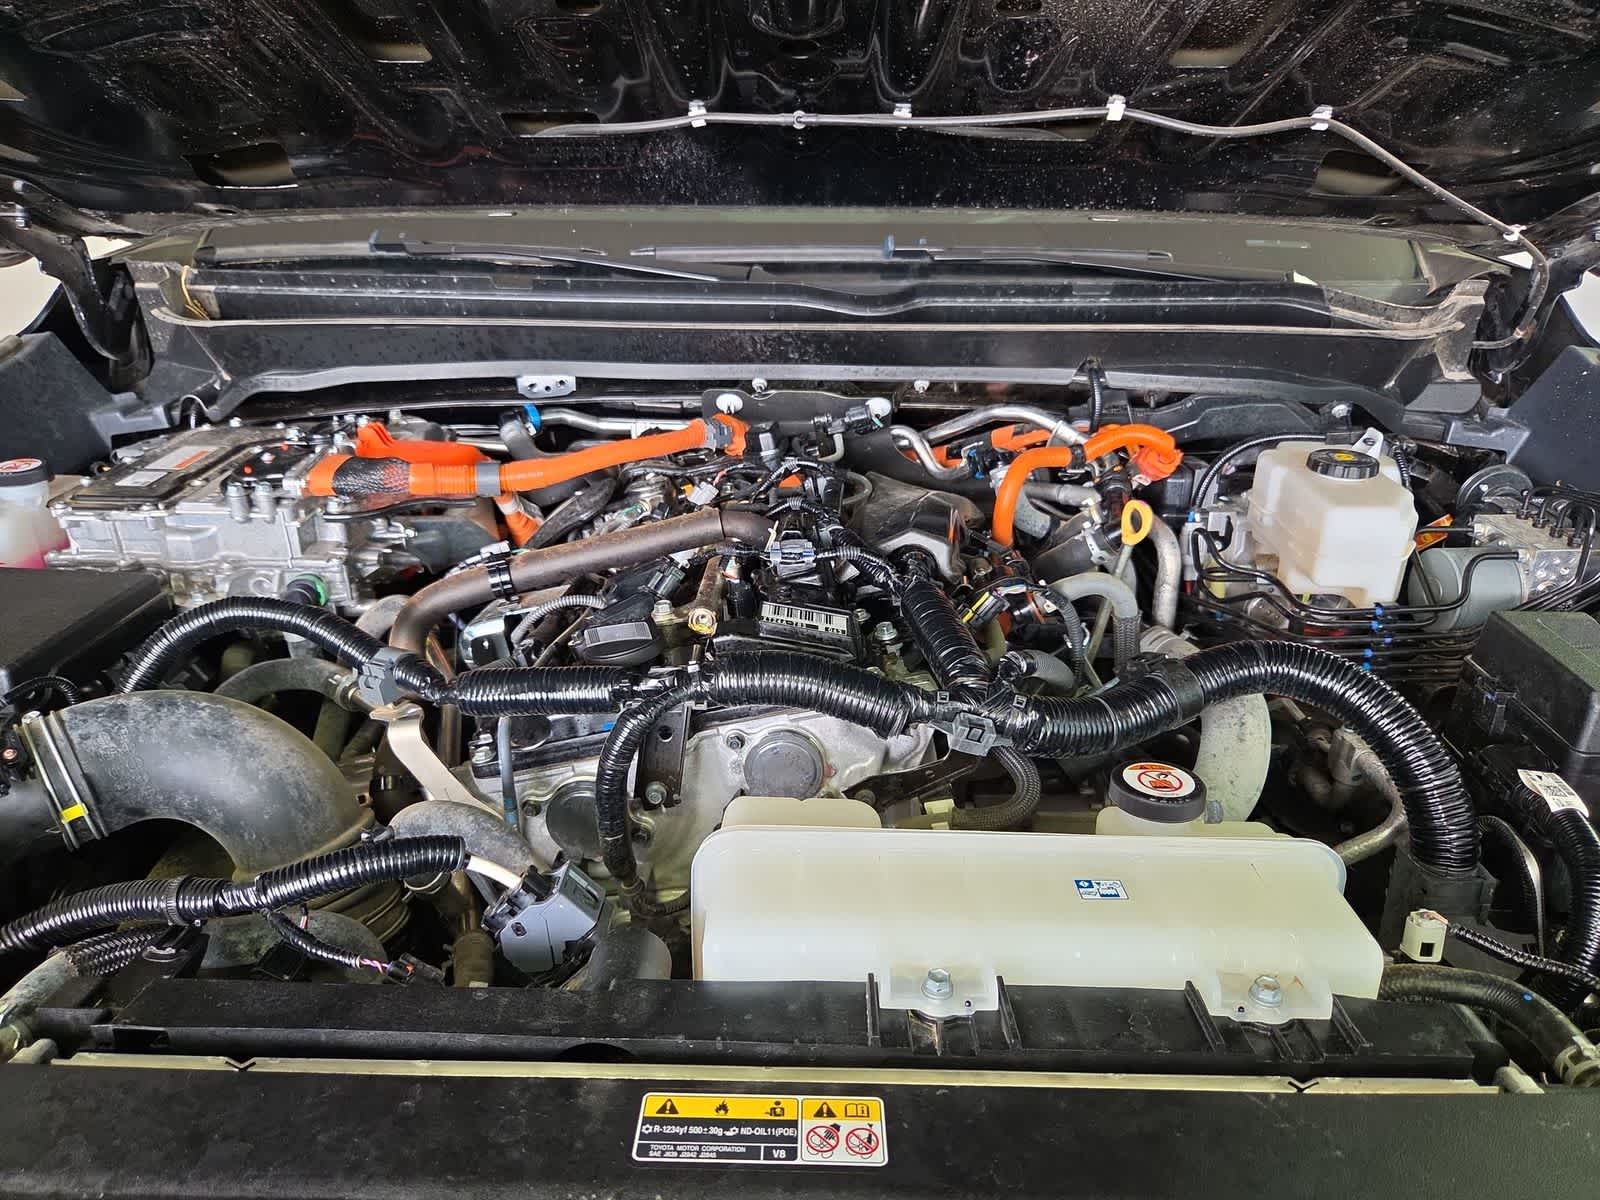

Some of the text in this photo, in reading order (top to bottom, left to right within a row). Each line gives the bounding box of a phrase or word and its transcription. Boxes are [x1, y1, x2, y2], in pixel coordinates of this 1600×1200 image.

[653, 1125, 688, 1135] R-1234yf
[740, 1127, 798, 1137] ND-OIL11(POE)
[701, 1145, 746, 1153] CORPORATION
